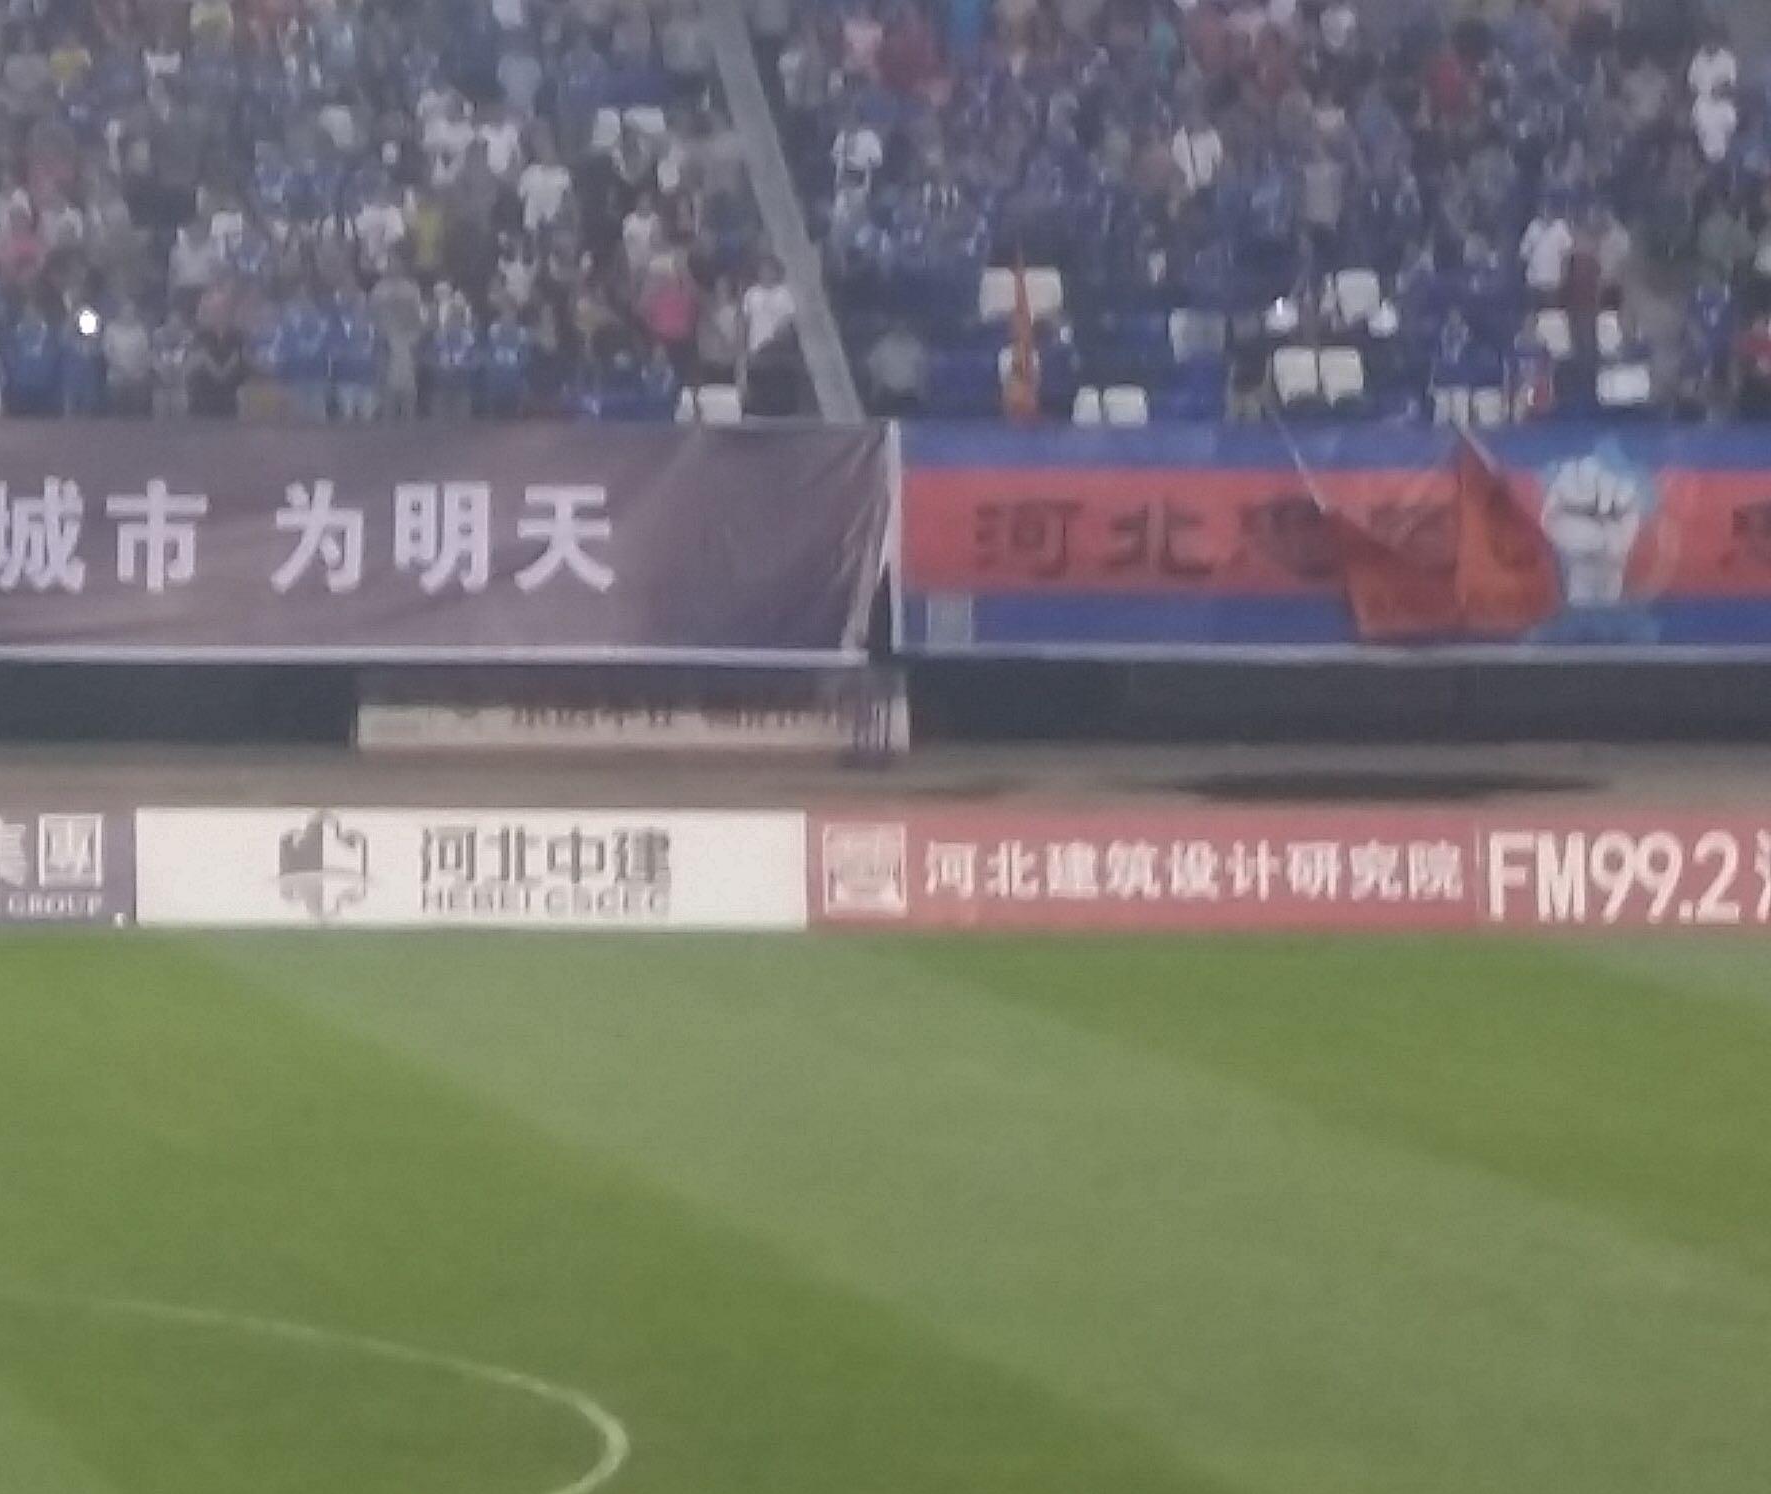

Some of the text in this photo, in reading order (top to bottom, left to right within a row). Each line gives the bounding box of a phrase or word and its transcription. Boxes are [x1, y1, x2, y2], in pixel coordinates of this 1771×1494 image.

[270, 480, 615, 592] 为明天
[420, 824, 670, 884] 河北中建
[923, 840, 1463, 901] 河北建筑设计研究院
[1487, 830, 1741, 923] FM99.2
